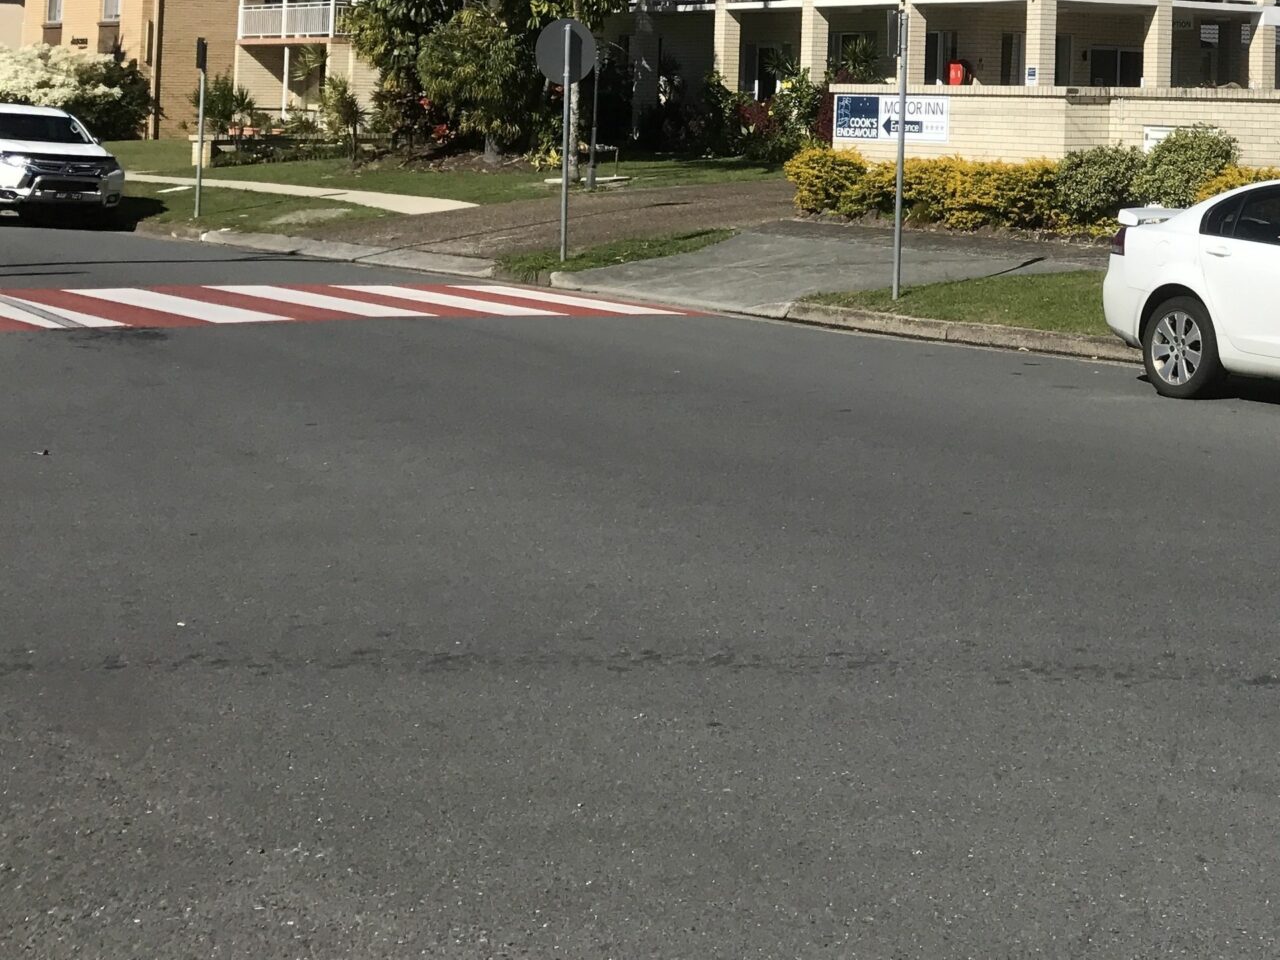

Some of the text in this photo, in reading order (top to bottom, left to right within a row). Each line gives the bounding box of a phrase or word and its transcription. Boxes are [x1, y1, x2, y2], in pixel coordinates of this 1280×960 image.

[925, 101, 944, 115] INN
[850, 117, 877, 128] COOK'S
[836, 128, 878, 138] ENDEAVOUR
